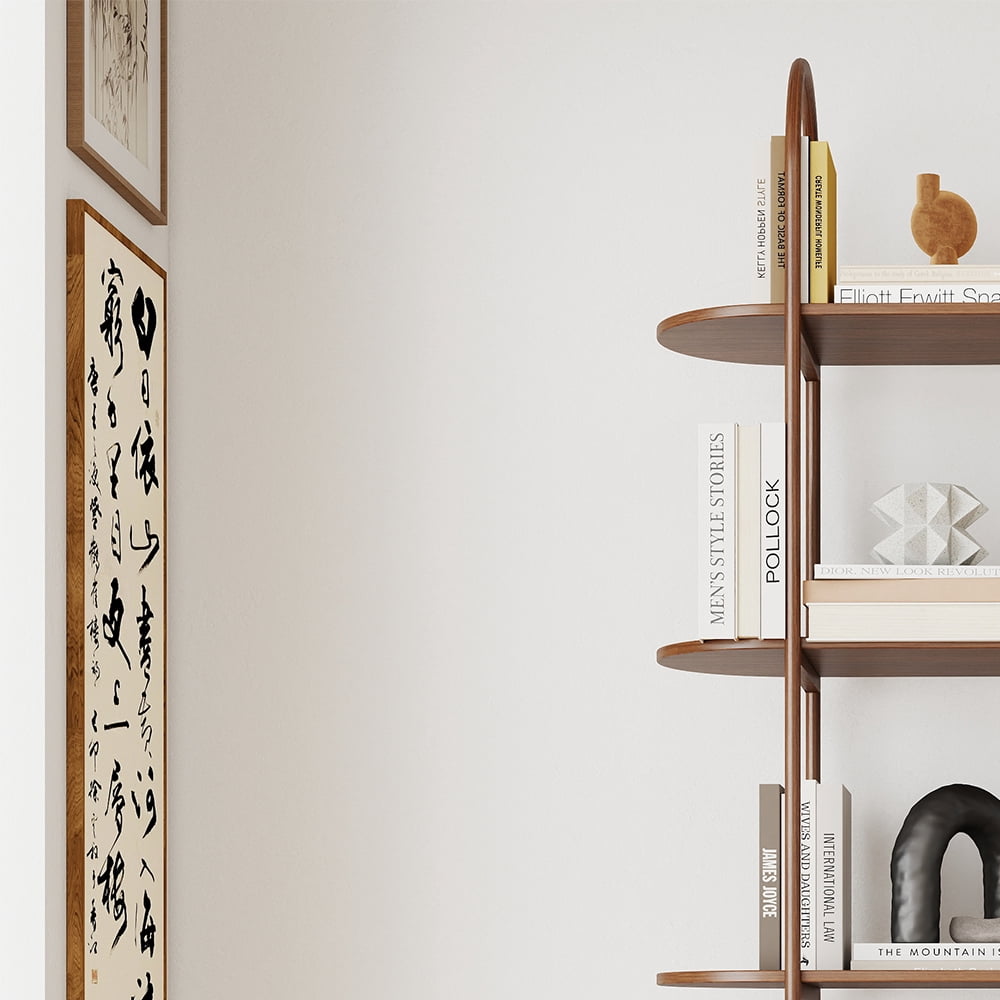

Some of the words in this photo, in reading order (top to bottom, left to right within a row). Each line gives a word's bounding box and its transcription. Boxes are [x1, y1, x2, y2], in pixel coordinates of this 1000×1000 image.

[839, 287, 891, 303] Elliott
[900, 287, 955, 303] Erwitt
[708, 432, 726, 507] STORIES
[708, 511, 726, 567] STYLE
[765, 478, 781, 584] POLLOCK
[862, 567, 892, 576] NEW
[896, 567, 934, 576] LOOK
[708, 570, 726, 625] MEN'S
[800, 801, 811, 841] WIVES
[762, 847, 778, 883] JAMES
[800, 843, 811, 871] AND
[823, 832, 836, 918] INTERNATIONAL
[762, 885, 778, 918] JOYCE
[800, 873, 811, 949] DAUGHTERS
[823, 921, 836, 943] LAW
[877, 948, 902, 957] THE
[909, 948, 987, 957] MOUNTAIN
